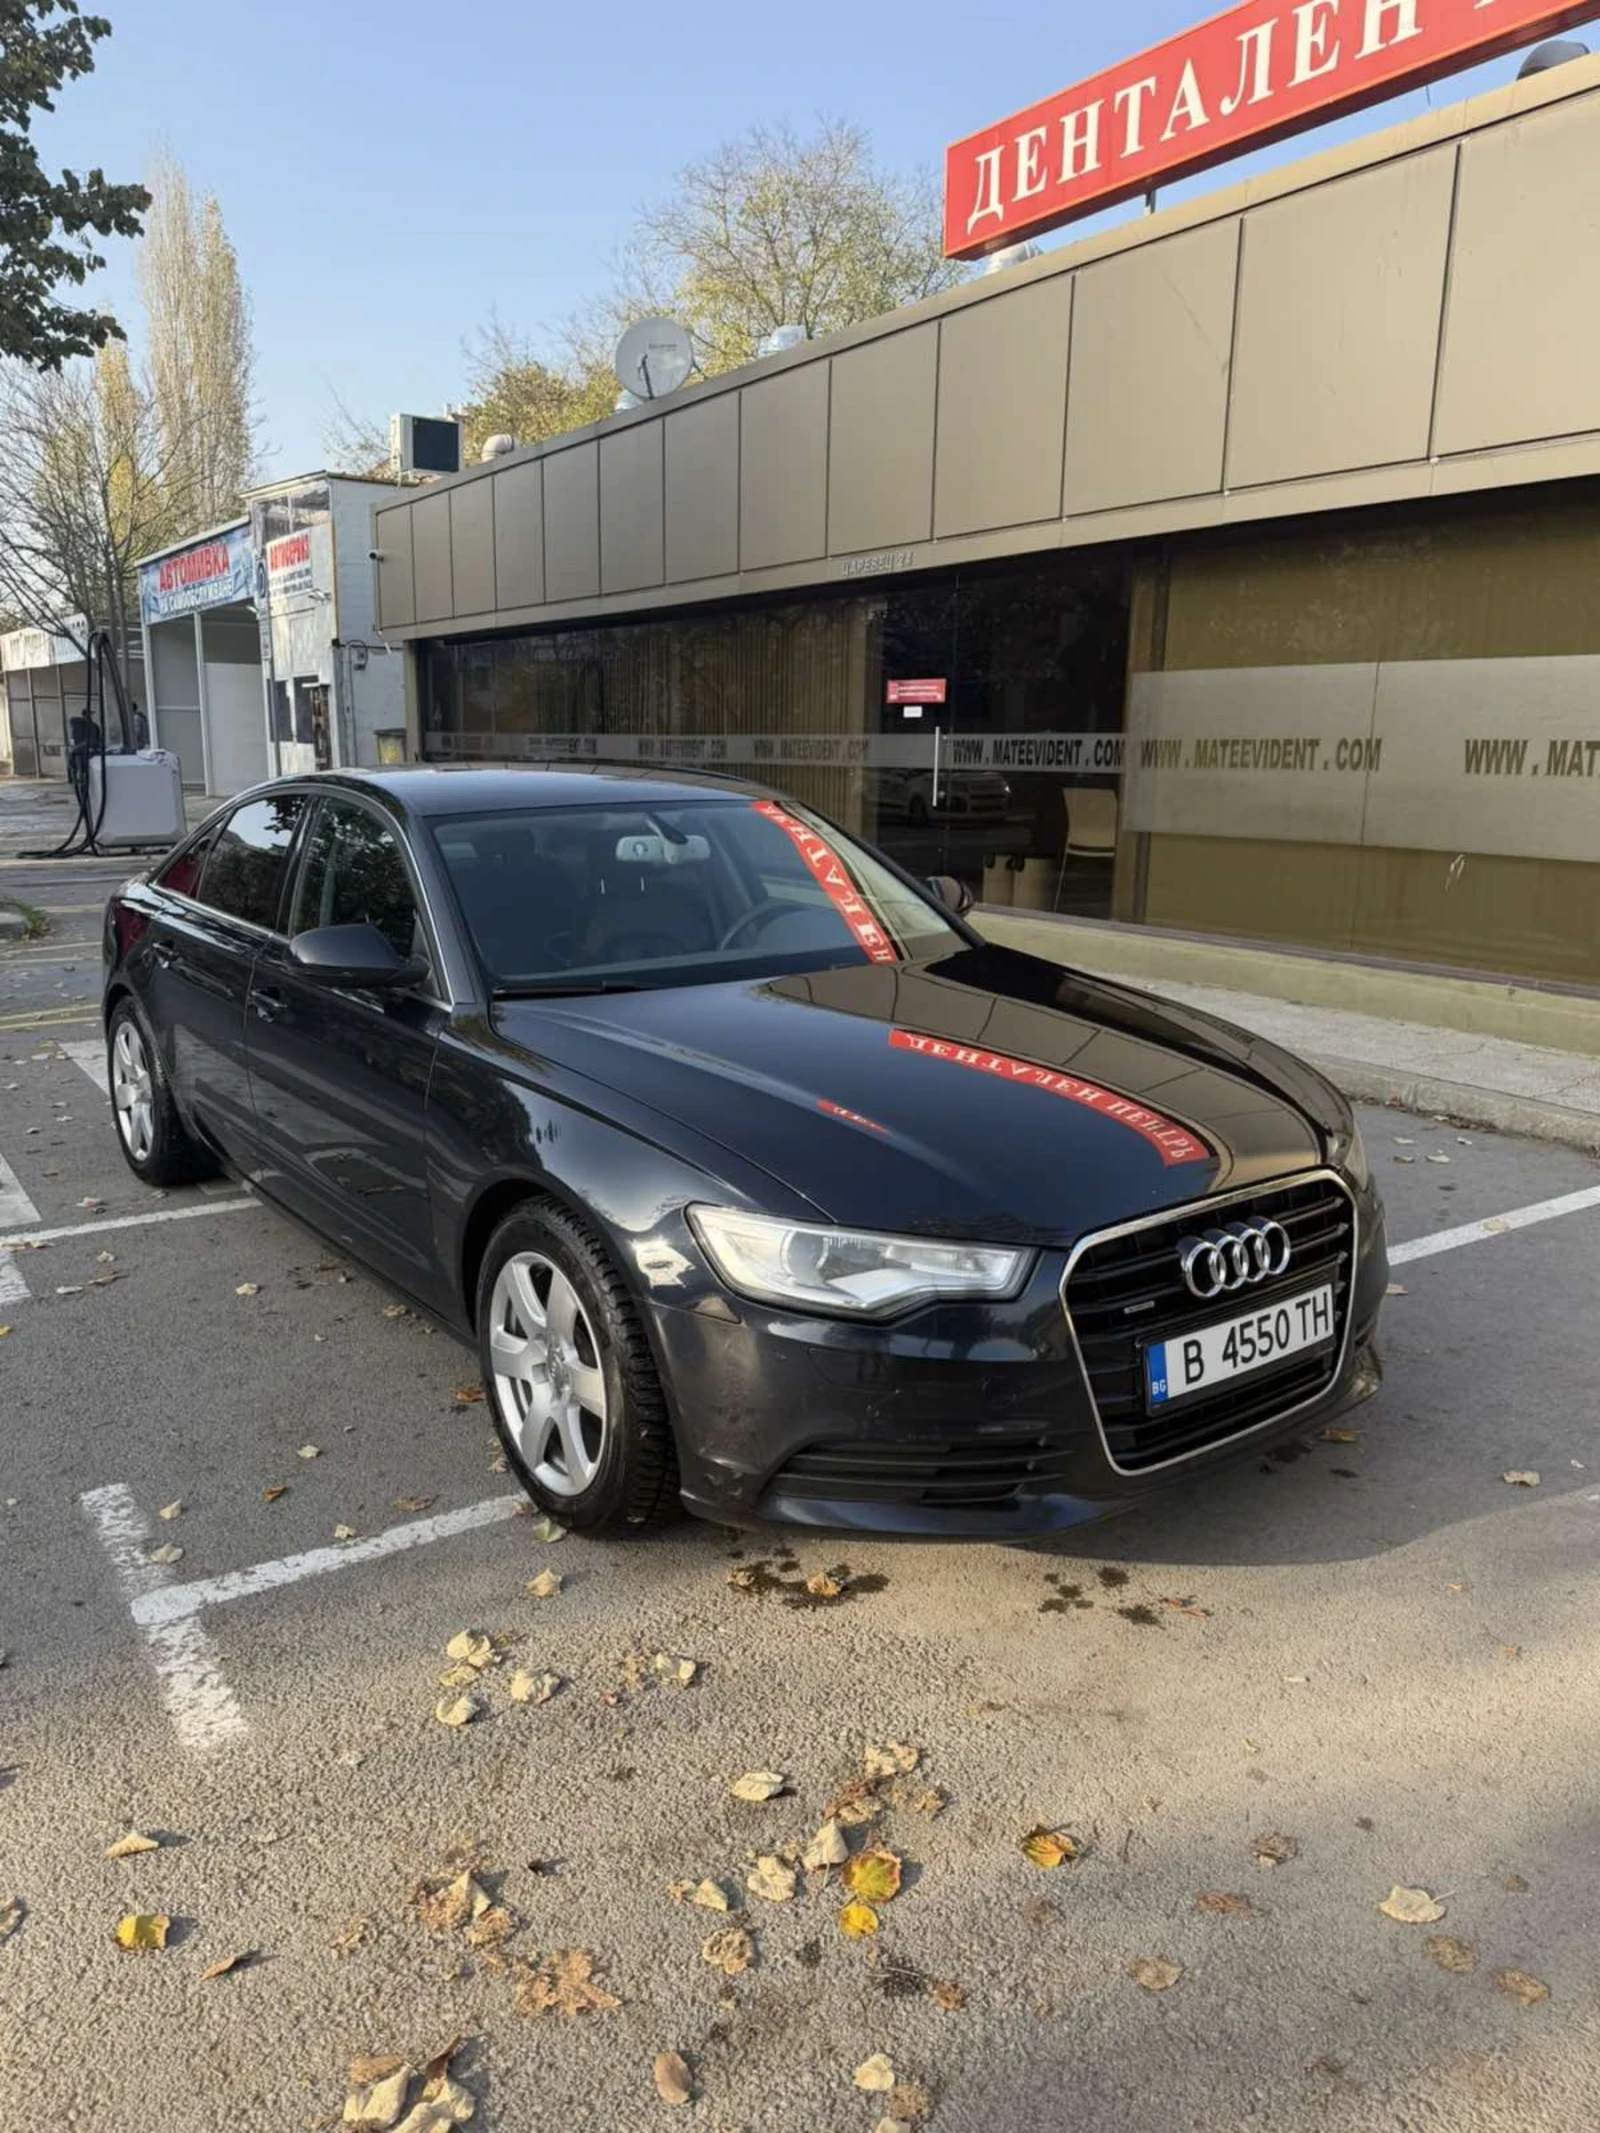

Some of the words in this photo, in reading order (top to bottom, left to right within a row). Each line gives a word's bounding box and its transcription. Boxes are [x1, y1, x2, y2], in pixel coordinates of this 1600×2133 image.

[967, 0, 1424, 234] ДЕНТАЛЕН
[1183, 1339, 1205, 1384] B
[1222, 1309, 1291, 1369] 4550
[1294, 1292, 1330, 1342] TH
[1151, 1380, 1167, 1395] BG
